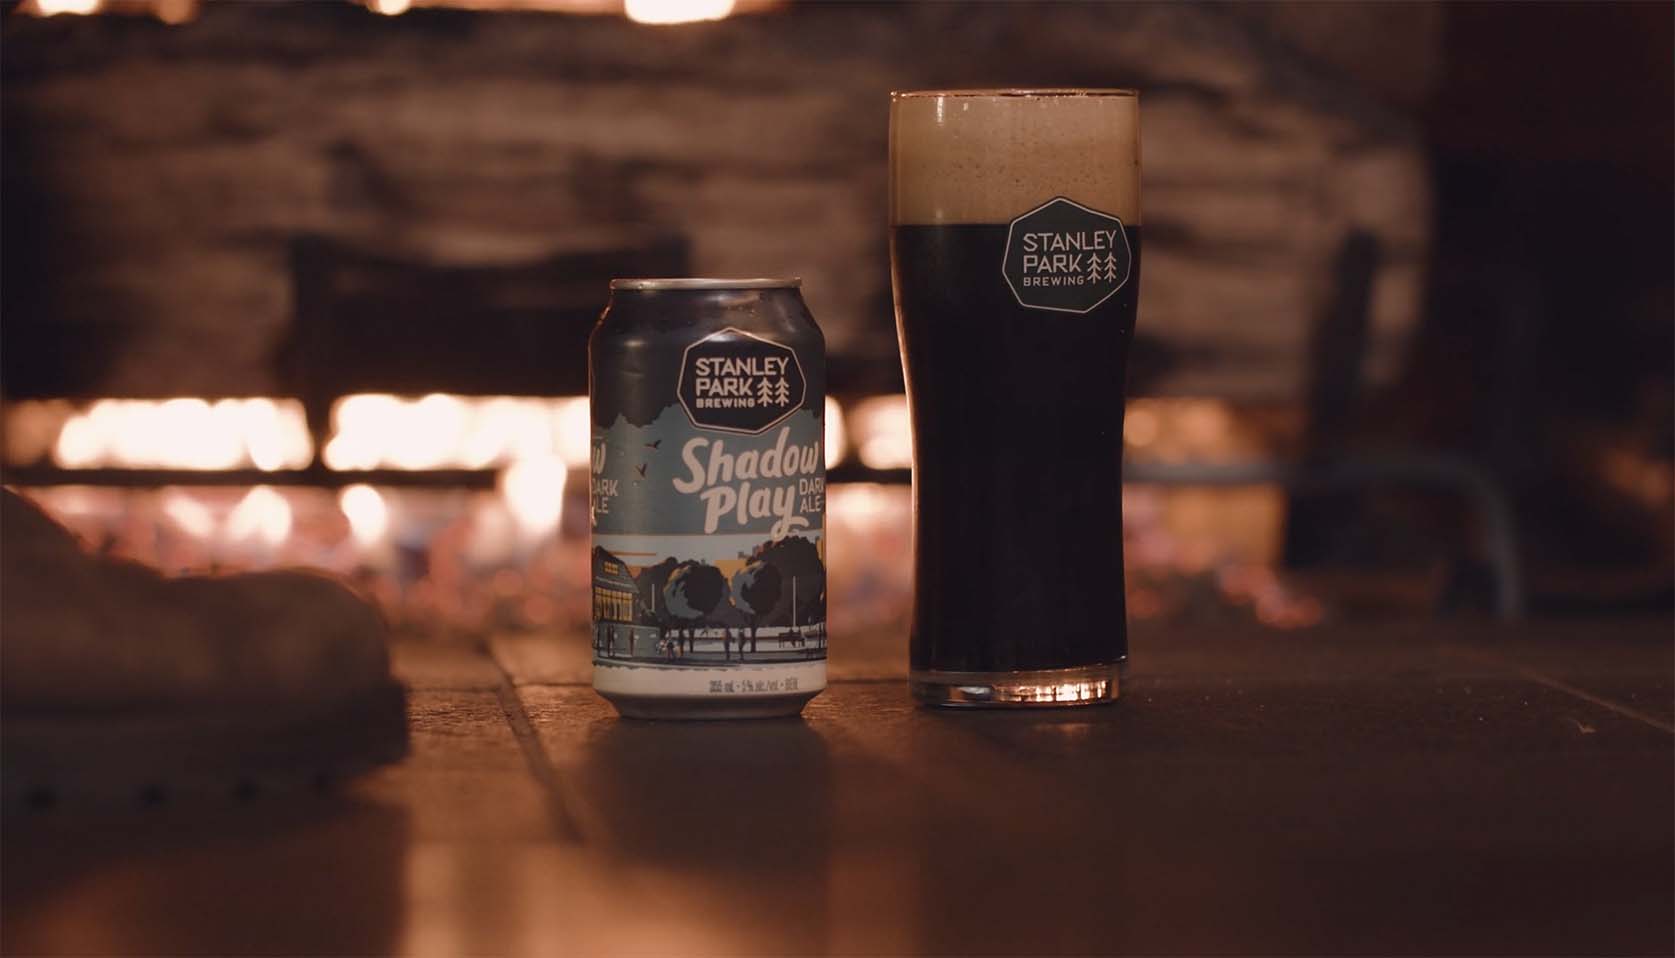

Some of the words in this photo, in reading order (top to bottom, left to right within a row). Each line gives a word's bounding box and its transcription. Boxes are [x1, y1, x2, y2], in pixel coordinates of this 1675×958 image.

[1023, 230, 1117, 252] STANLEY
[1023, 253, 1082, 274] PARK
[1023, 276, 1084, 287] BREWING
[696, 357, 789, 376] STANLEY
[696, 377, 753, 396] PARK
[696, 398, 755, 408] BREWING
[672, 426, 818, 494] Shadow
[700, 481, 809, 541] Play
[800, 496, 821, 512] ALE
